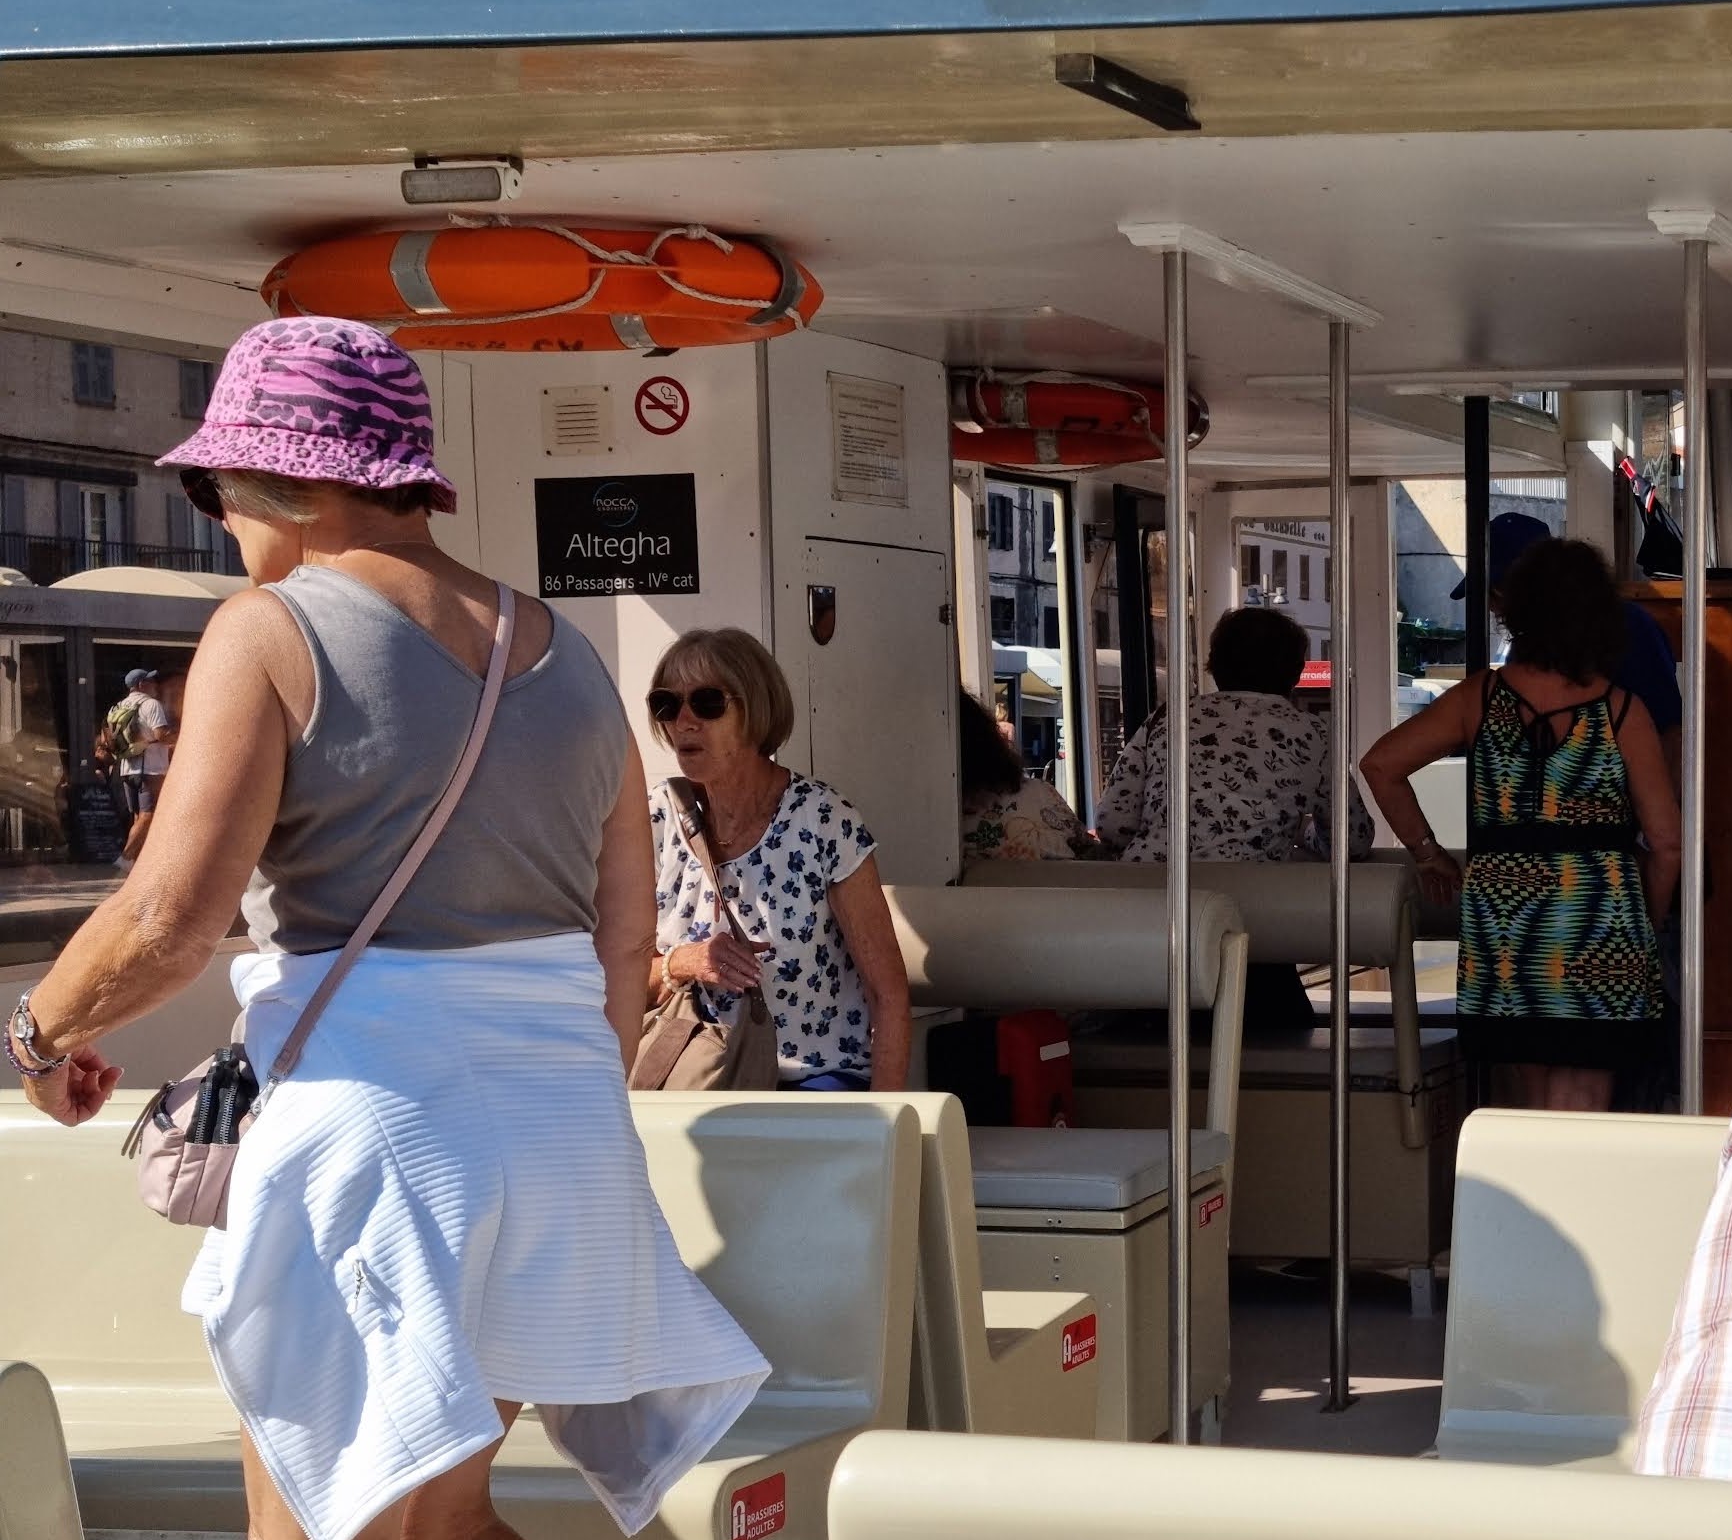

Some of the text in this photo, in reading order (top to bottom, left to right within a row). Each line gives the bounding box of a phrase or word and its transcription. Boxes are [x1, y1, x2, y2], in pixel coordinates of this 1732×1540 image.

[565, 531, 671, 565] Altegha
[544, 576, 562, 591] 86
[566, 574, 635, 594] Passagers
[672, 573, 694, 588] cat
[1072, 1349, 1090, 1365] ADULTES
[747, 1500, 784, 1525] BRASSIERES
[747, 1518, 775, 1540] ADULTES
